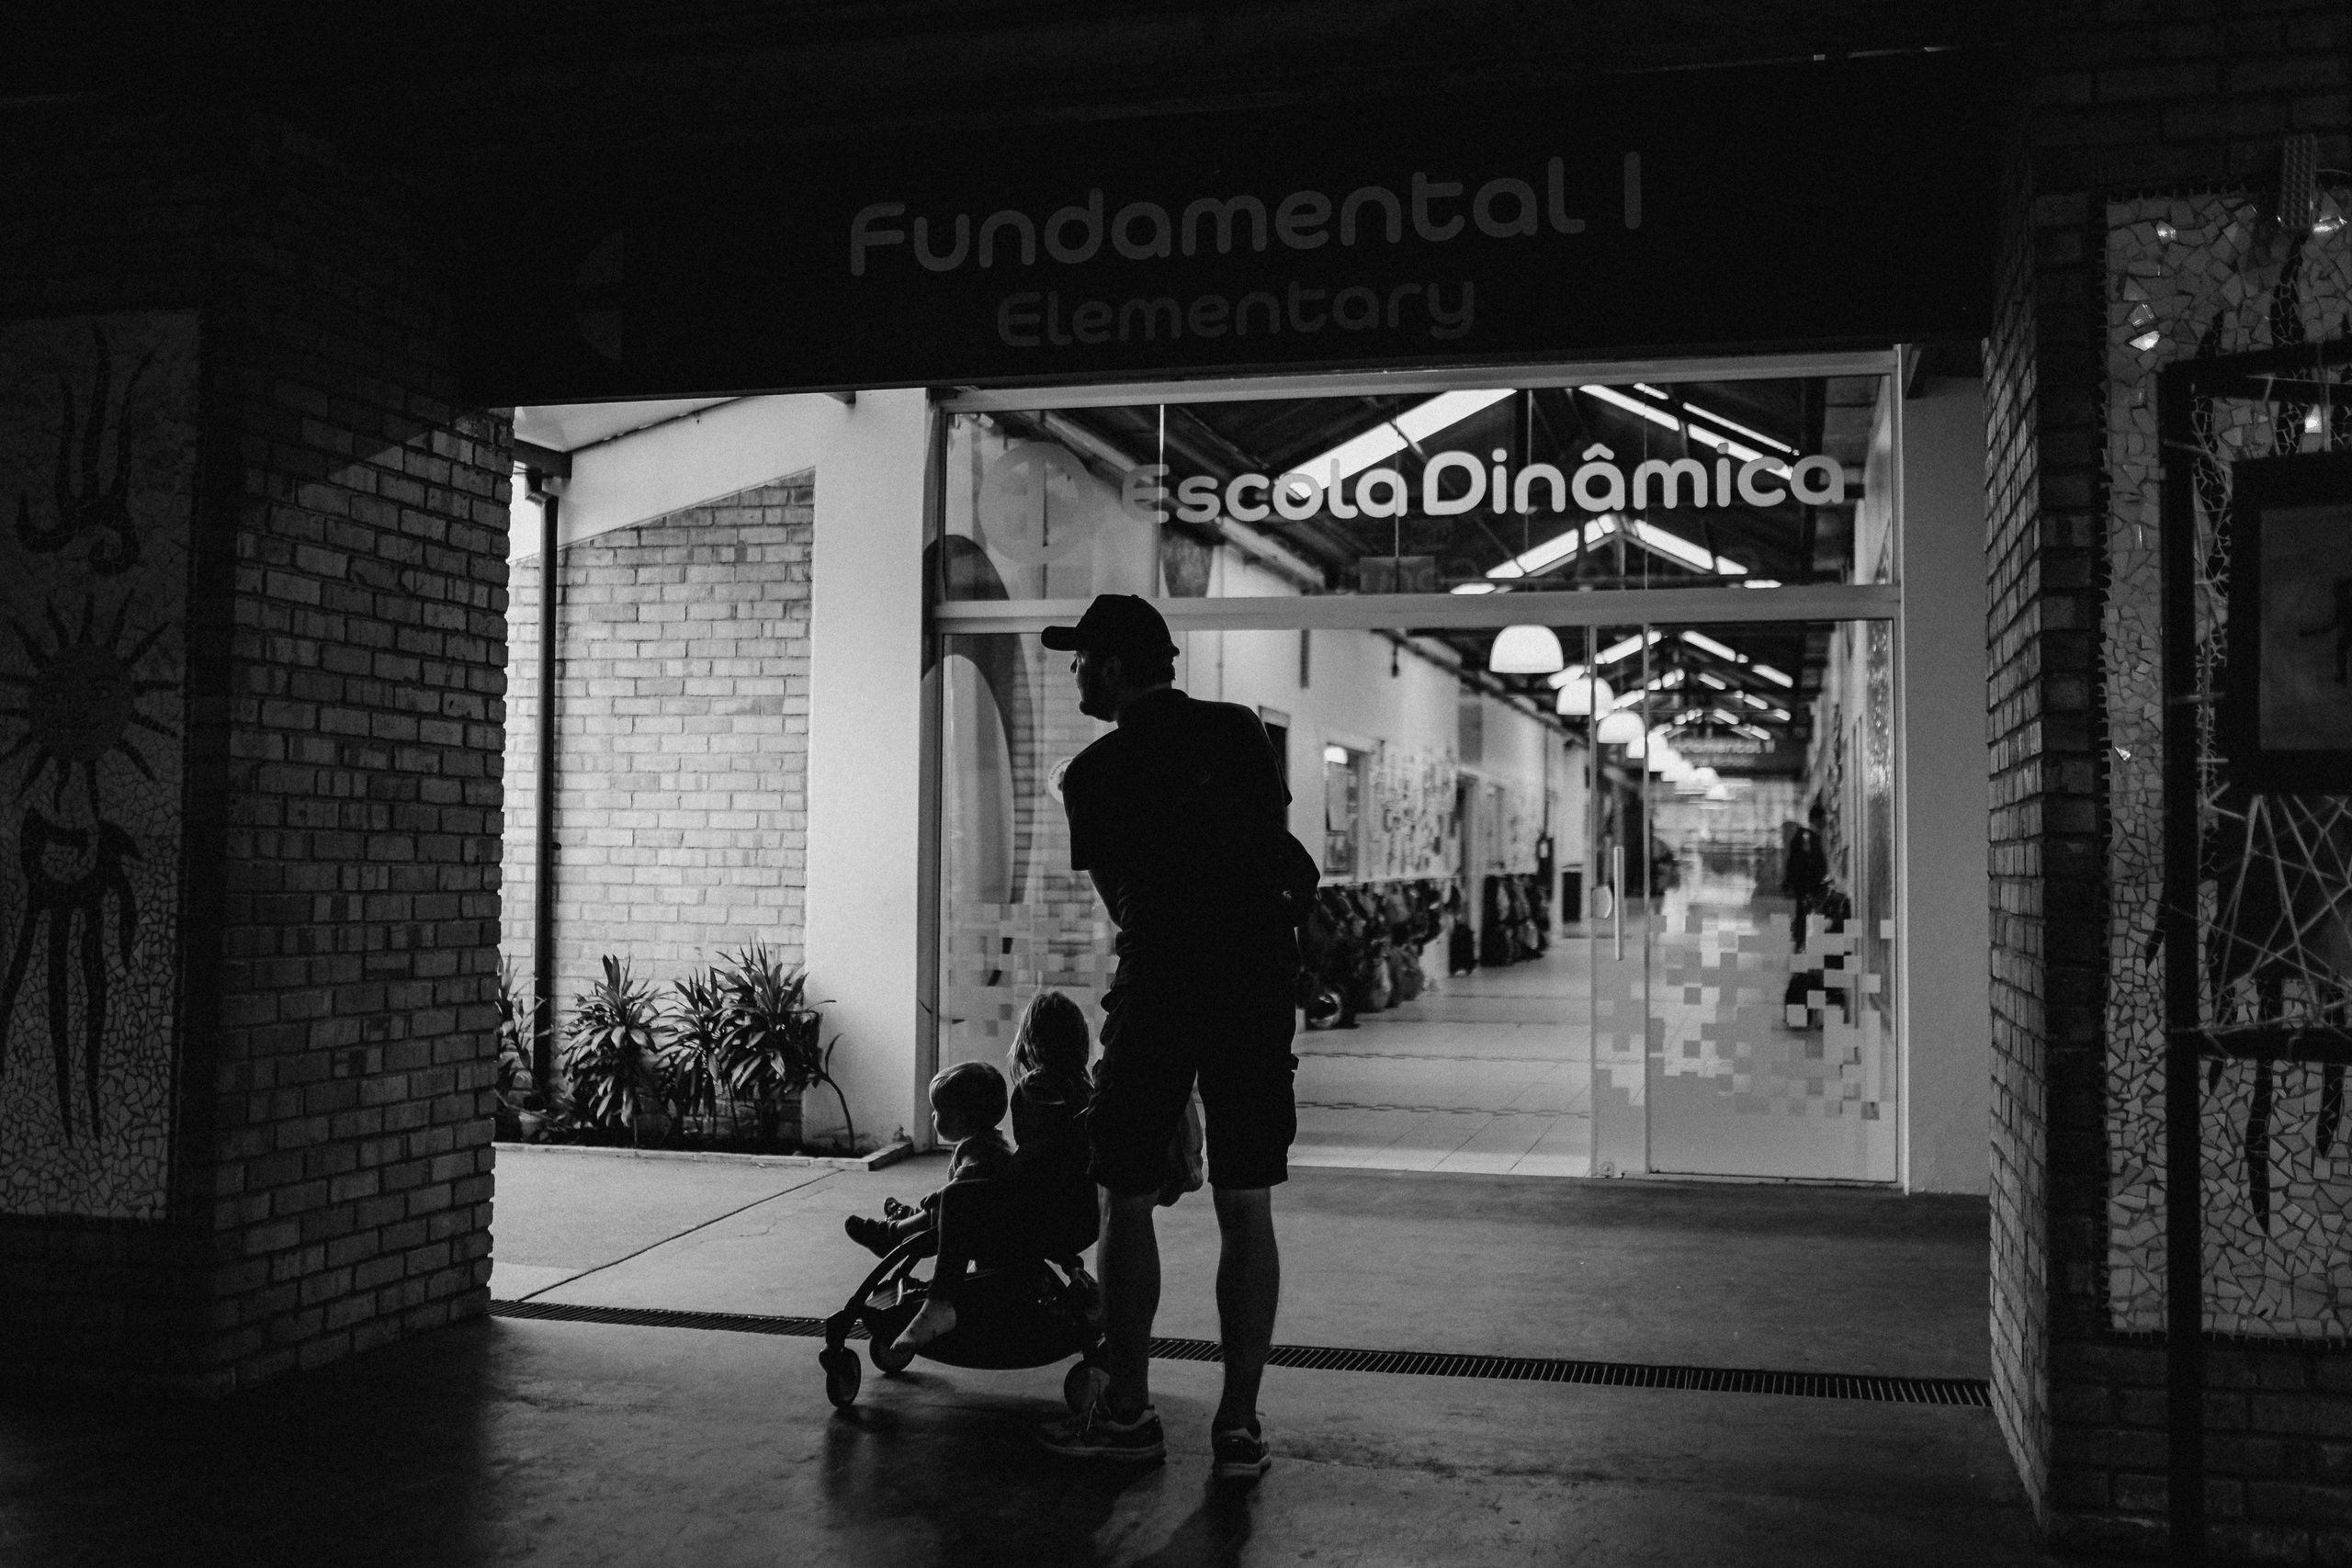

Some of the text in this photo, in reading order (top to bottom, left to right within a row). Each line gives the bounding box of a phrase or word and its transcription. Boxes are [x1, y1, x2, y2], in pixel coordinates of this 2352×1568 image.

[850, 151, 1642, 276] Fundamental I
[997, 280, 1475, 347] Elementary
[1122, 443, 1846, 525] Escola Dinâmica
